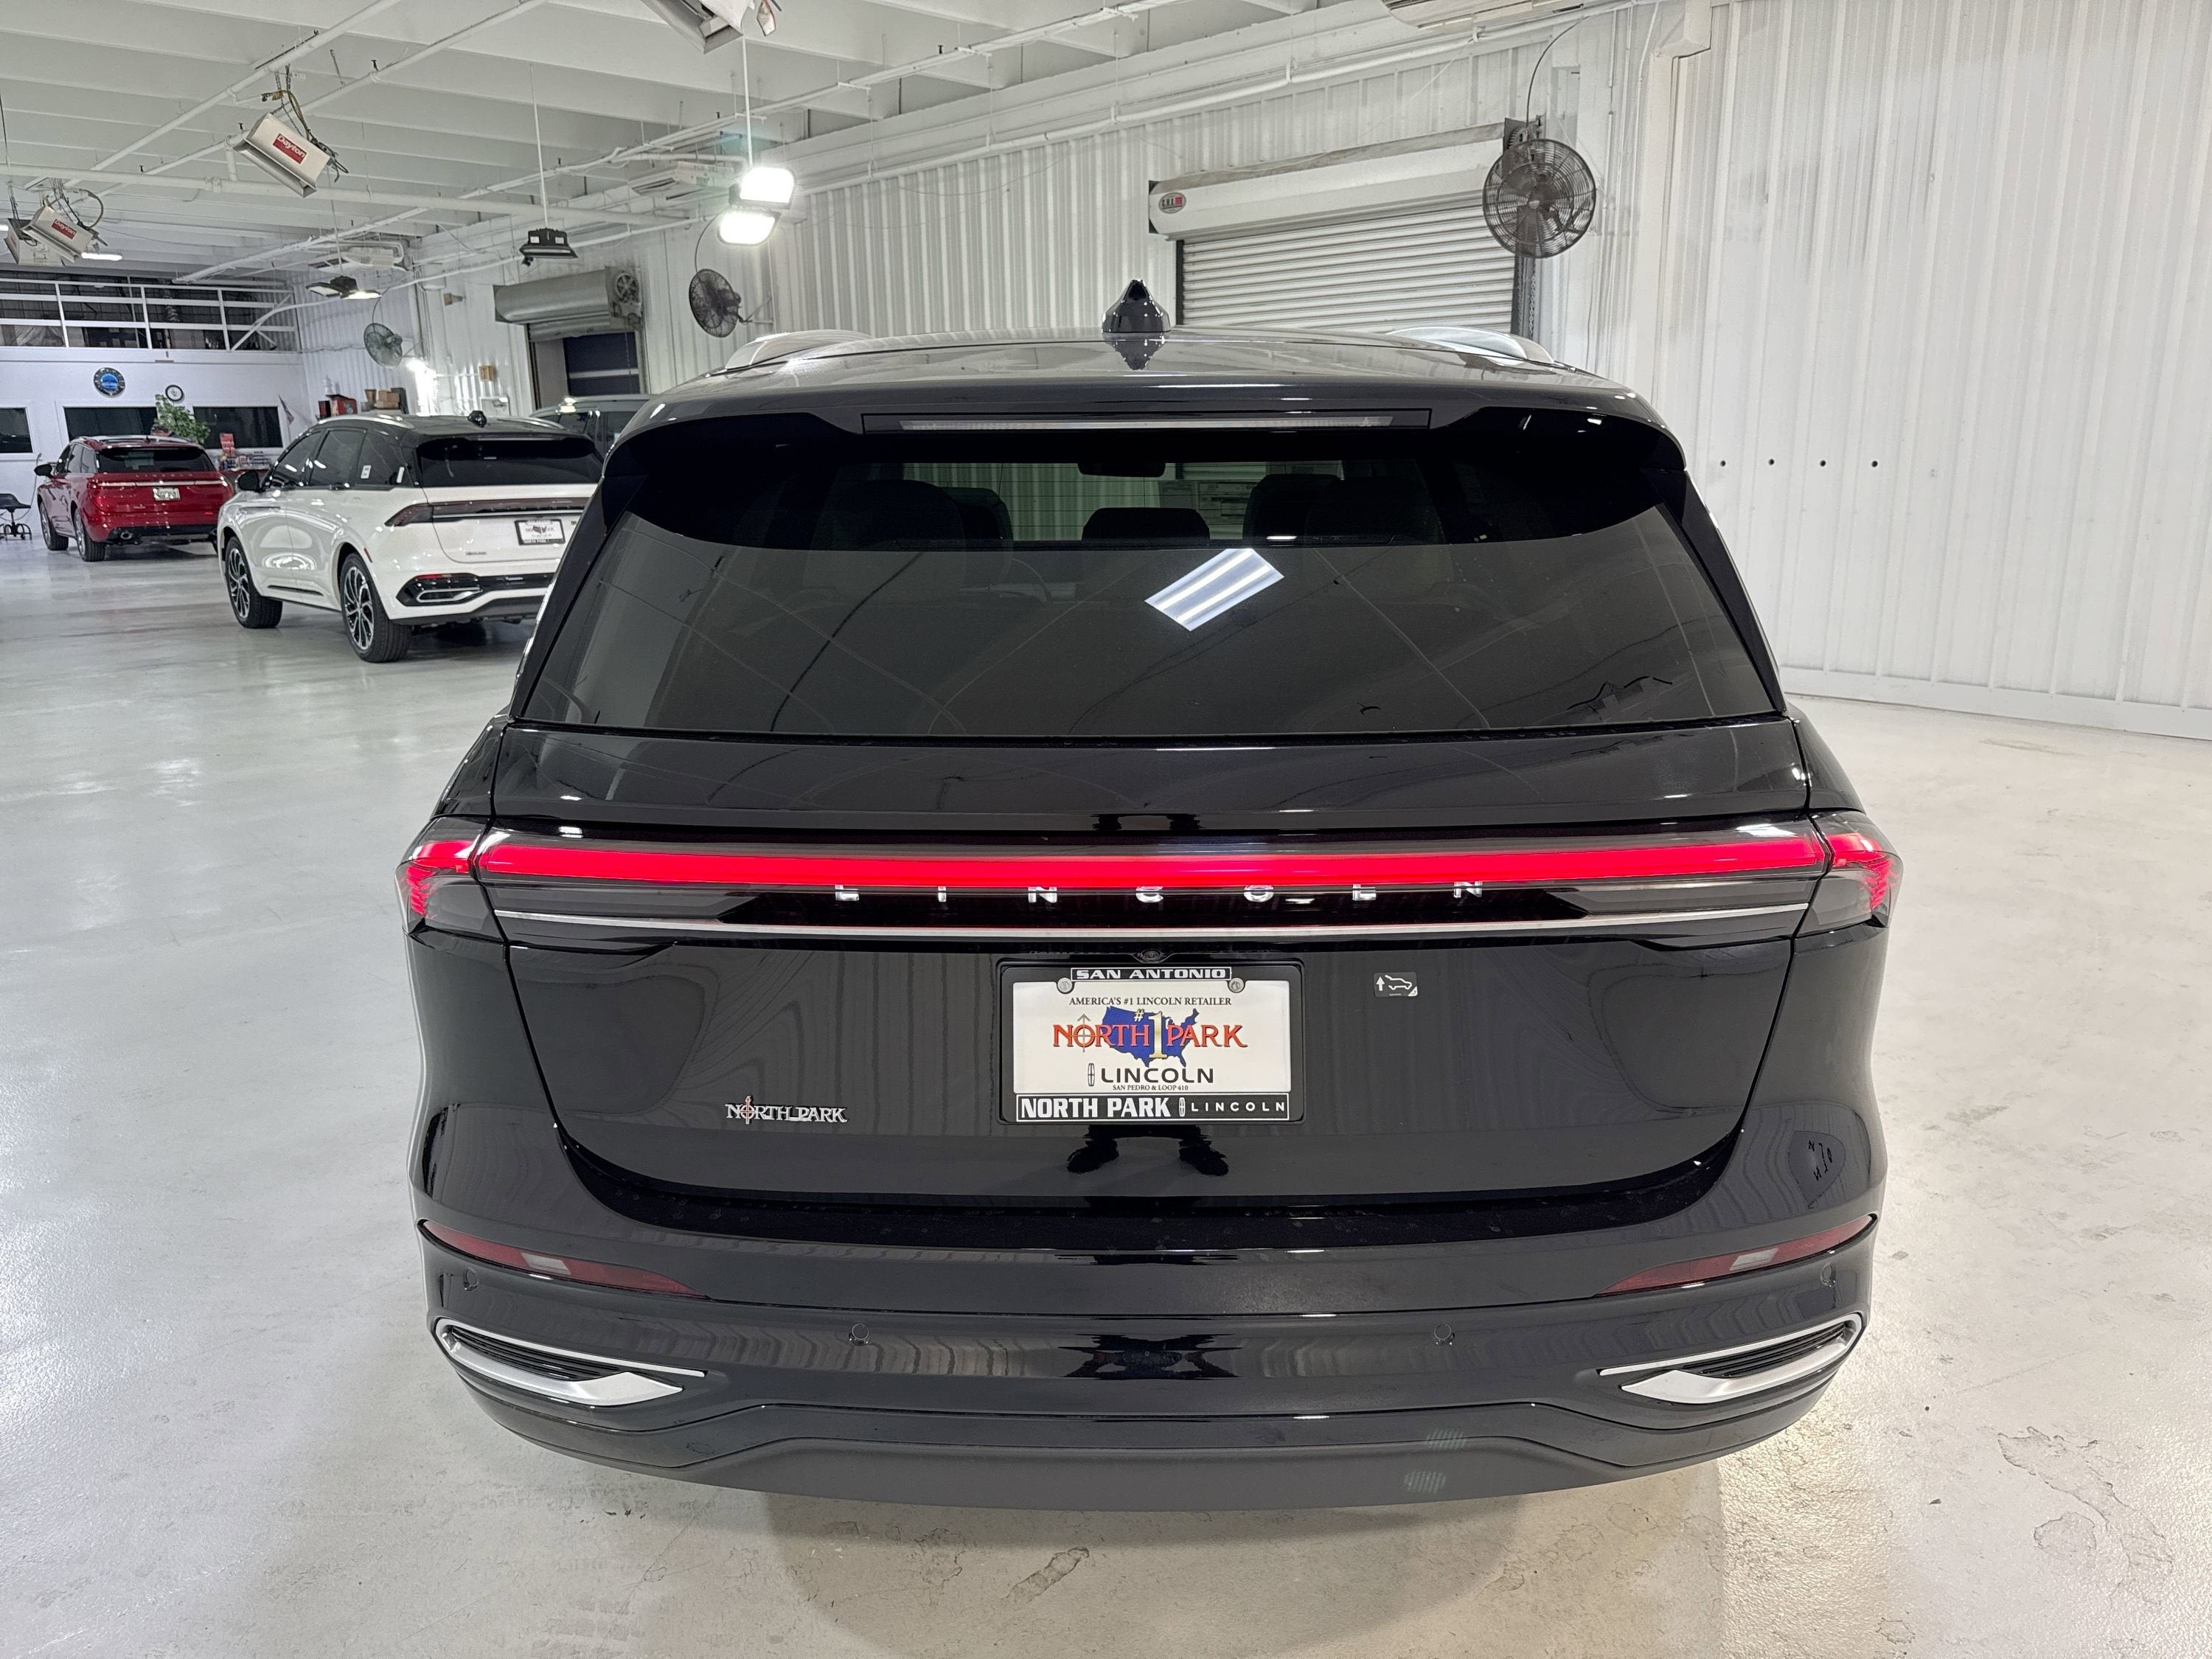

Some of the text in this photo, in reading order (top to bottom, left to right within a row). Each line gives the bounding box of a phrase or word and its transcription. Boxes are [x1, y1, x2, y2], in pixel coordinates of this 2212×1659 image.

[276, 136, 306, 158] Dayton
[55, 220, 76, 236] Dayton
[835, 881, 1483, 903] LINCOLN
[1077, 969, 1225, 979] SAN ANTONIO
[1069, 997, 1232, 1005] AMERICA'S #1 LINCOLN RETAILER
[1053, 1024, 1248, 1048] NORTH PARK
[1101, 1068, 1214, 1084] LINCOLN
[726, 1104, 847, 1123] NORTH PARK
[1021, 1097, 1284, 1118] NORTH PARK LINCOLN
